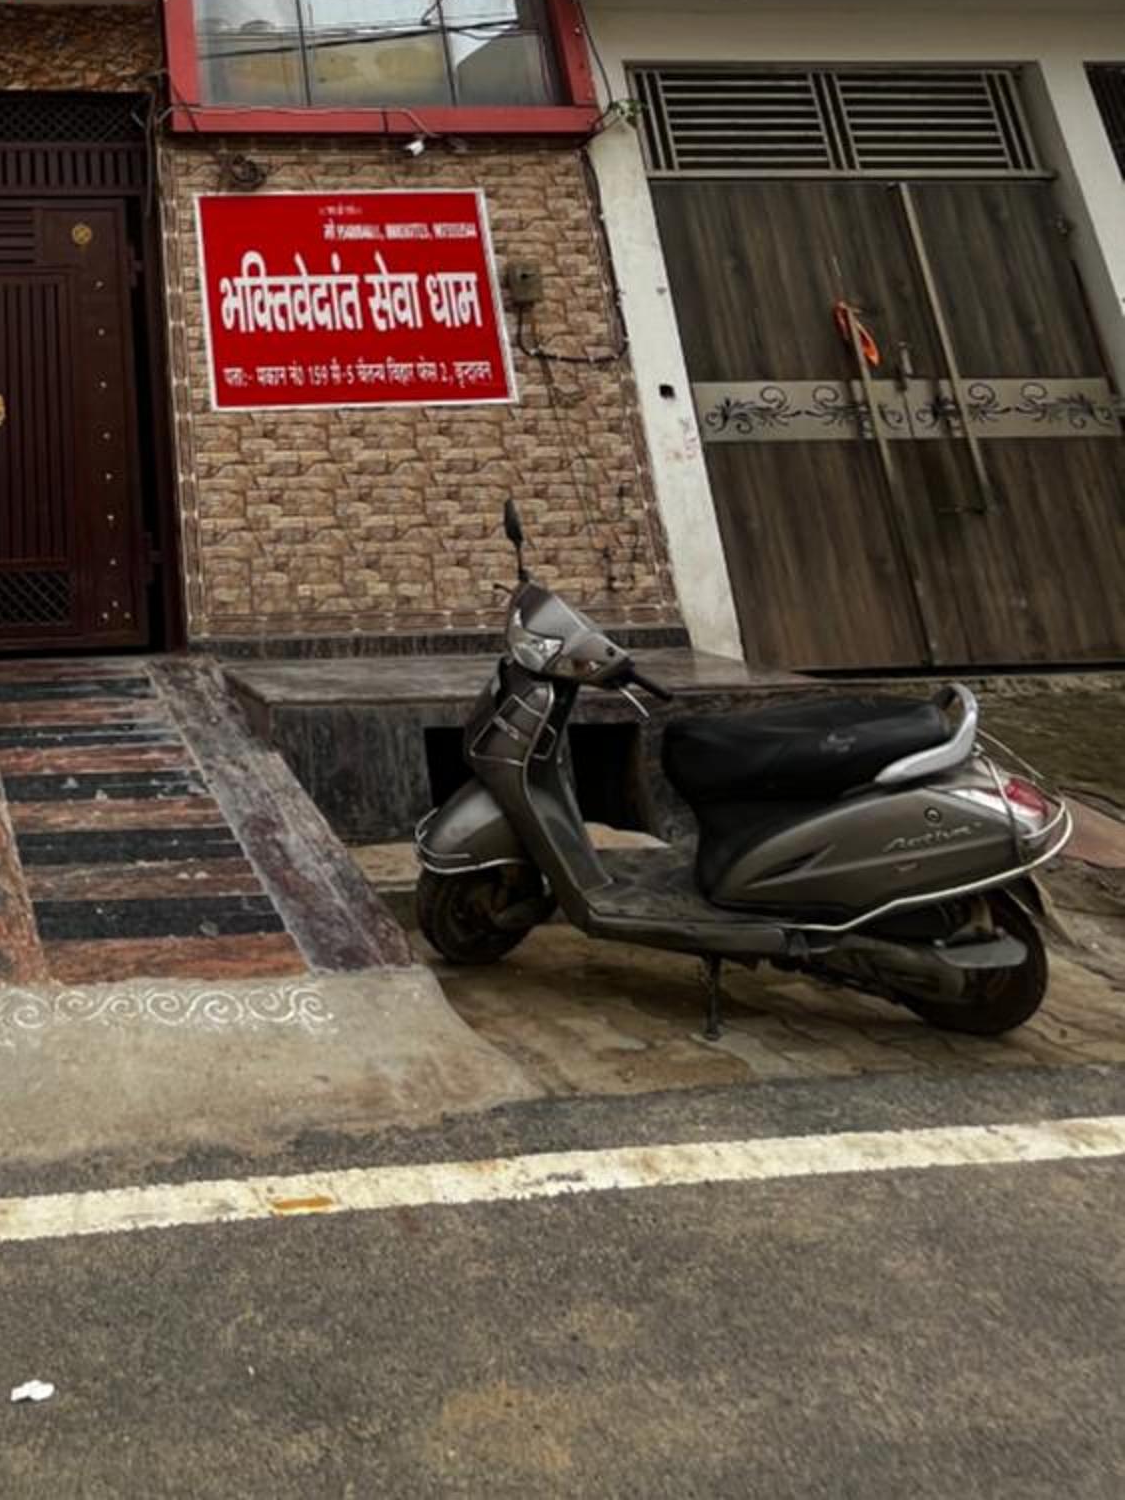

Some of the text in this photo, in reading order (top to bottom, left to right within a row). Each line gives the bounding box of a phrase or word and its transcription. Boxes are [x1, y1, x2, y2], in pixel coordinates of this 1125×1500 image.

[218, 250, 483, 333] भक्तिवेदांत सेवा धाम
